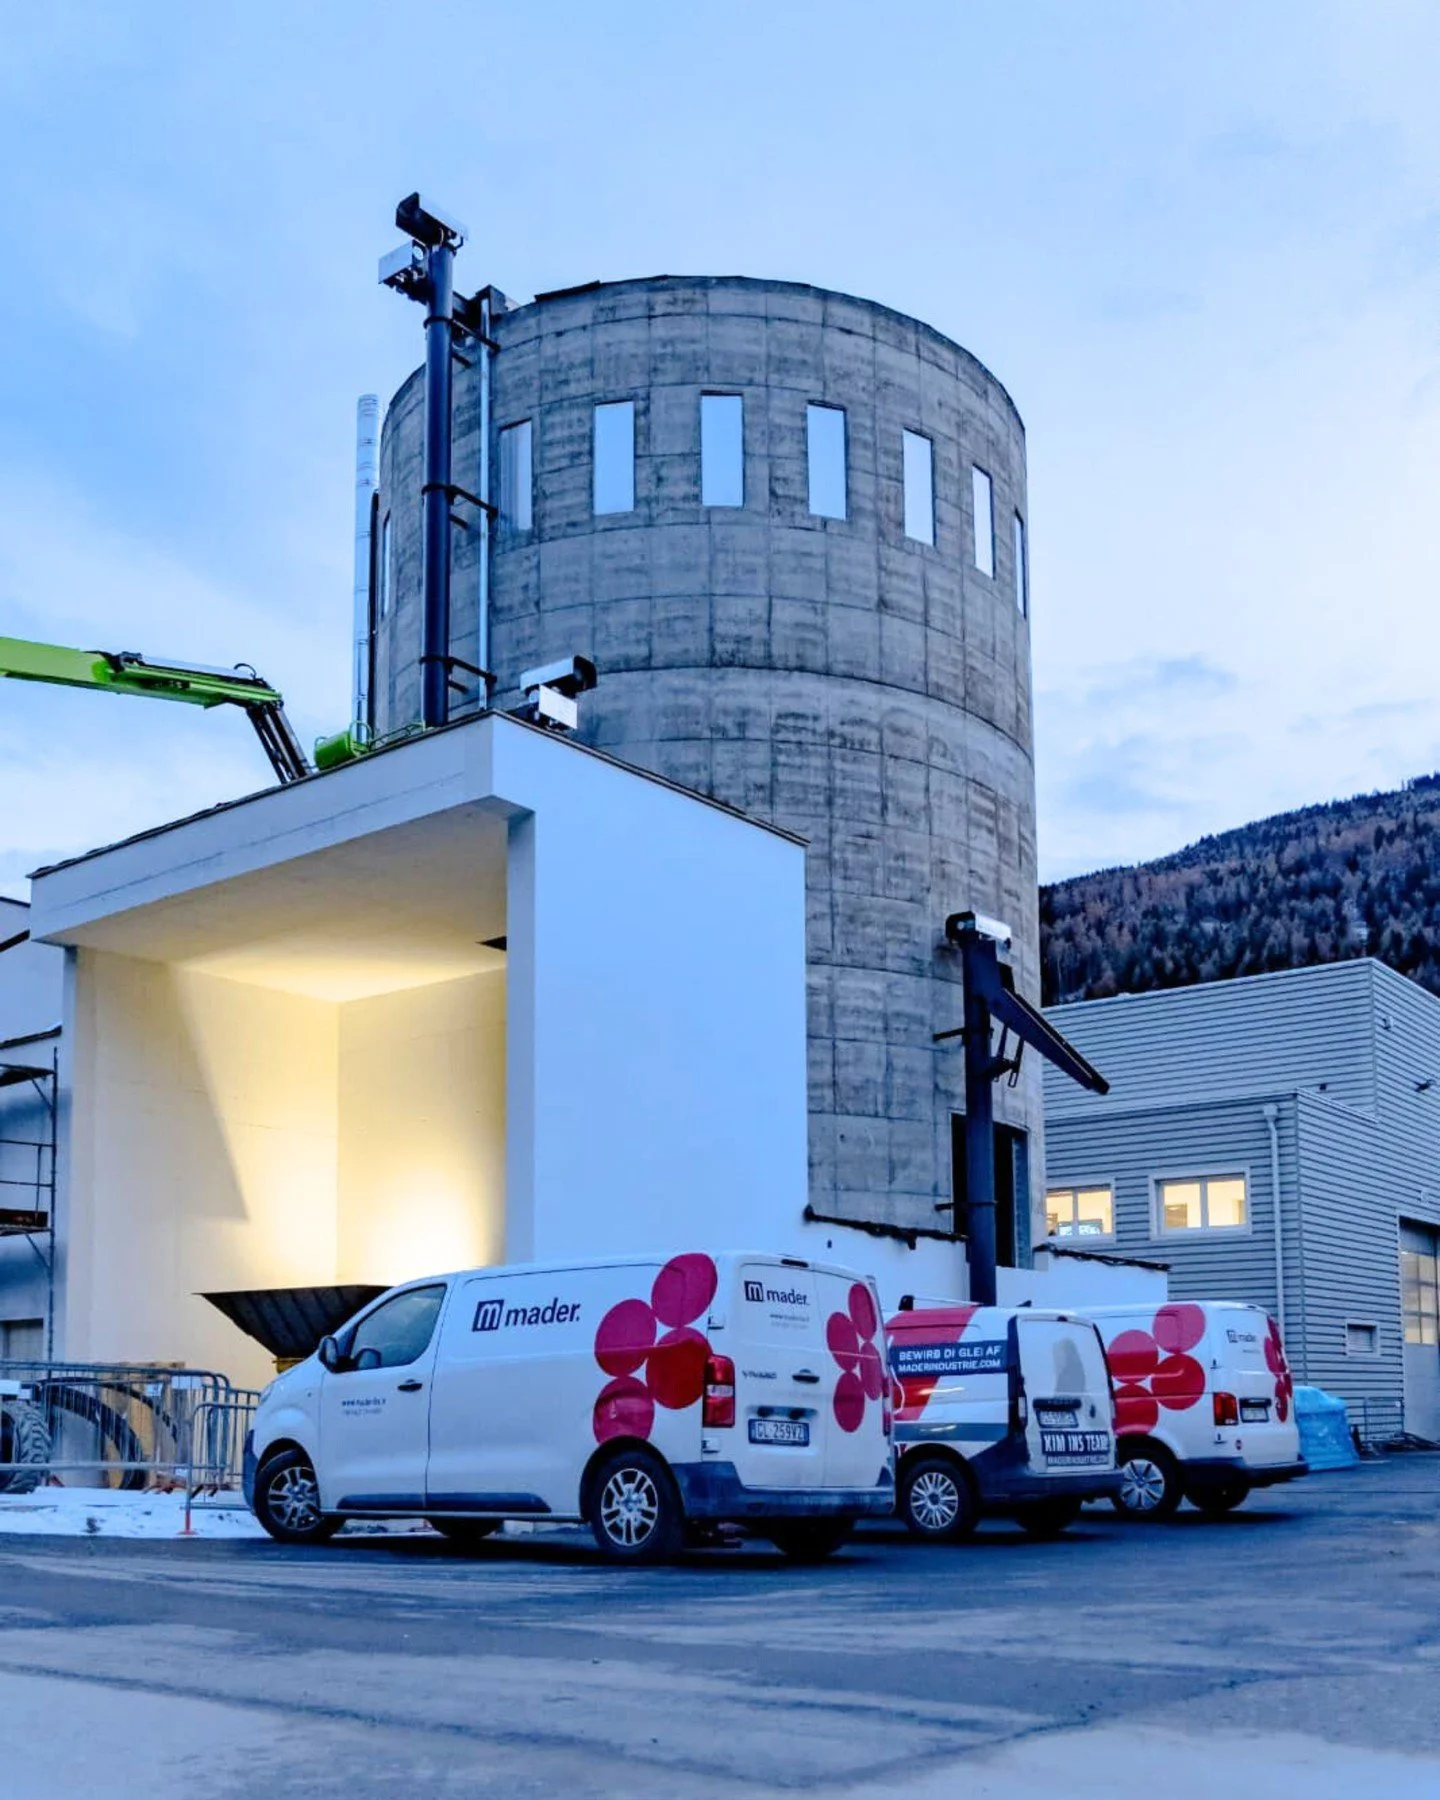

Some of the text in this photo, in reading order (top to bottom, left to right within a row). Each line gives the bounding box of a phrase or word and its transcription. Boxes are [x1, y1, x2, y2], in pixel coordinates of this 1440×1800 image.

[505, 1297, 581, 1327] mader.
[899, 1348, 941, 1361] BEWIRB
[985, 1344, 1002, 1356] AF
